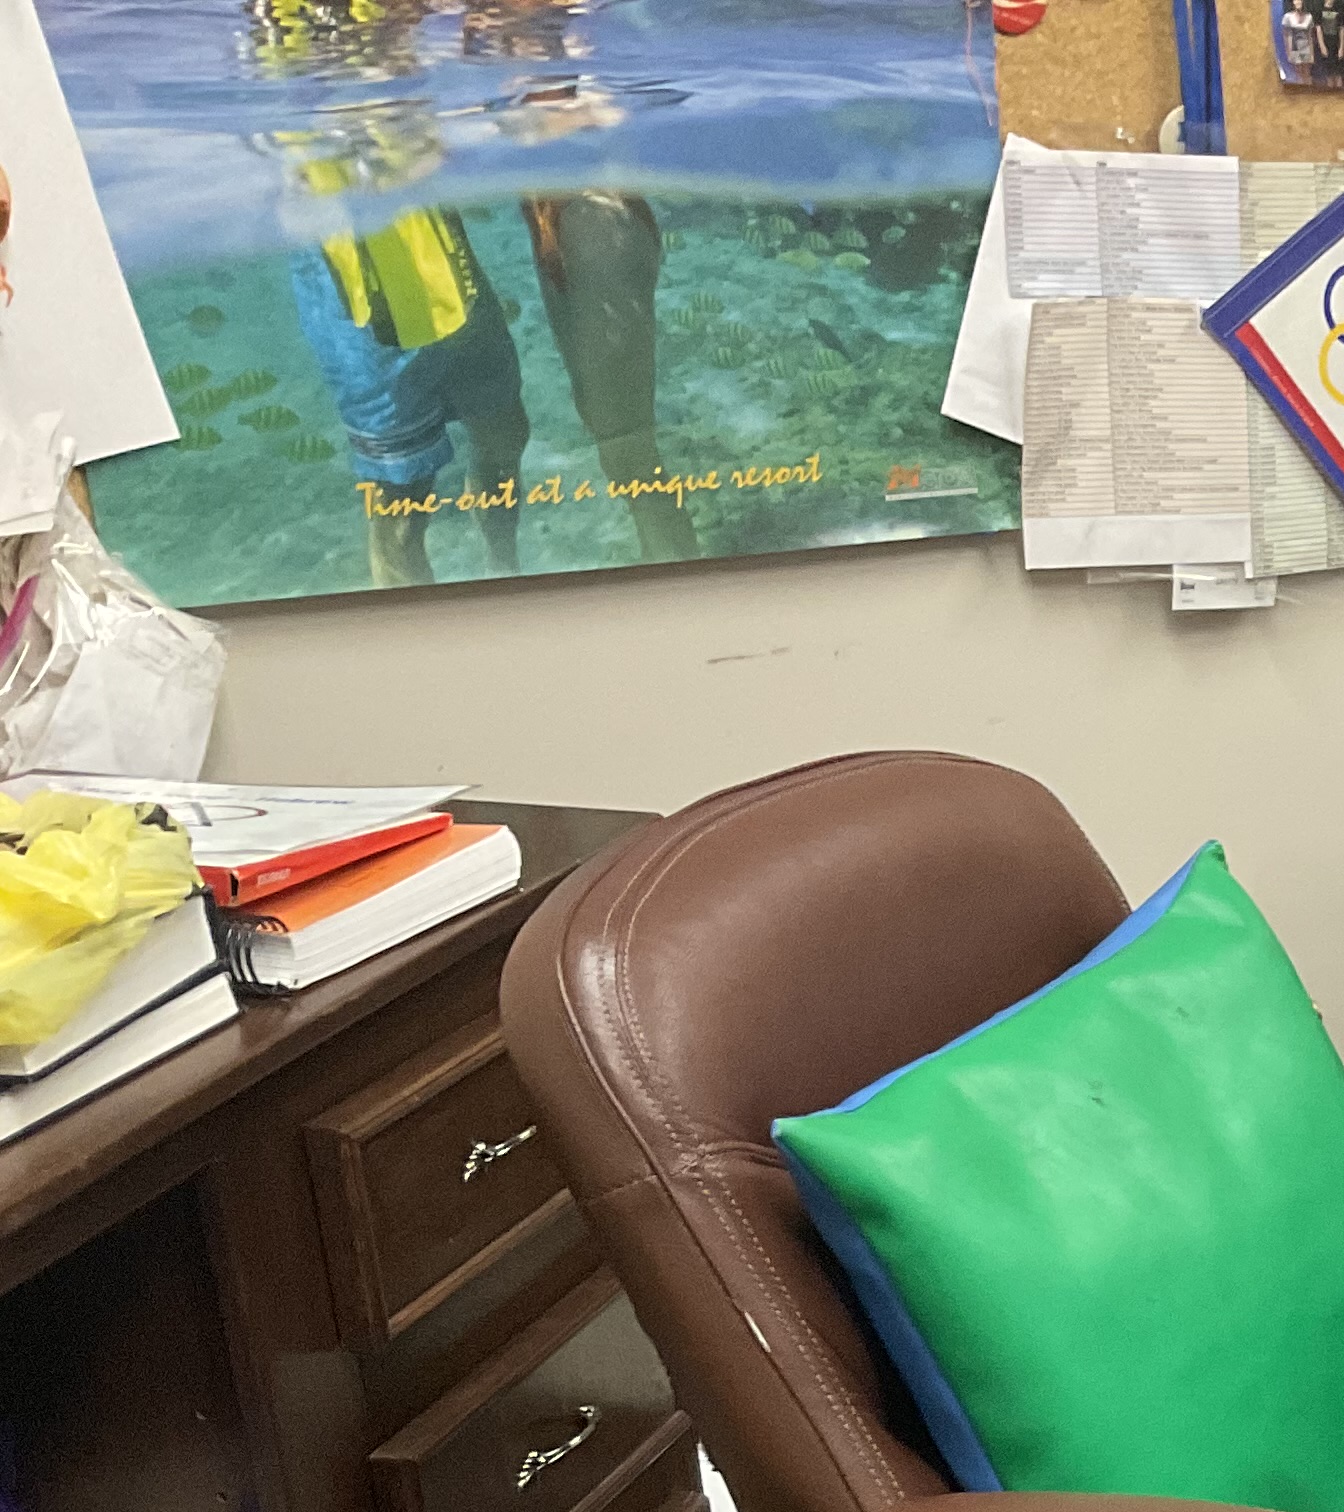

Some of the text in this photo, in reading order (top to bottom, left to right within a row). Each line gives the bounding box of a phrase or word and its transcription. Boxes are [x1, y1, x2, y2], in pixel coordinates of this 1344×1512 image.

[356, 453, 823, 519] Time-out at a unique resort
